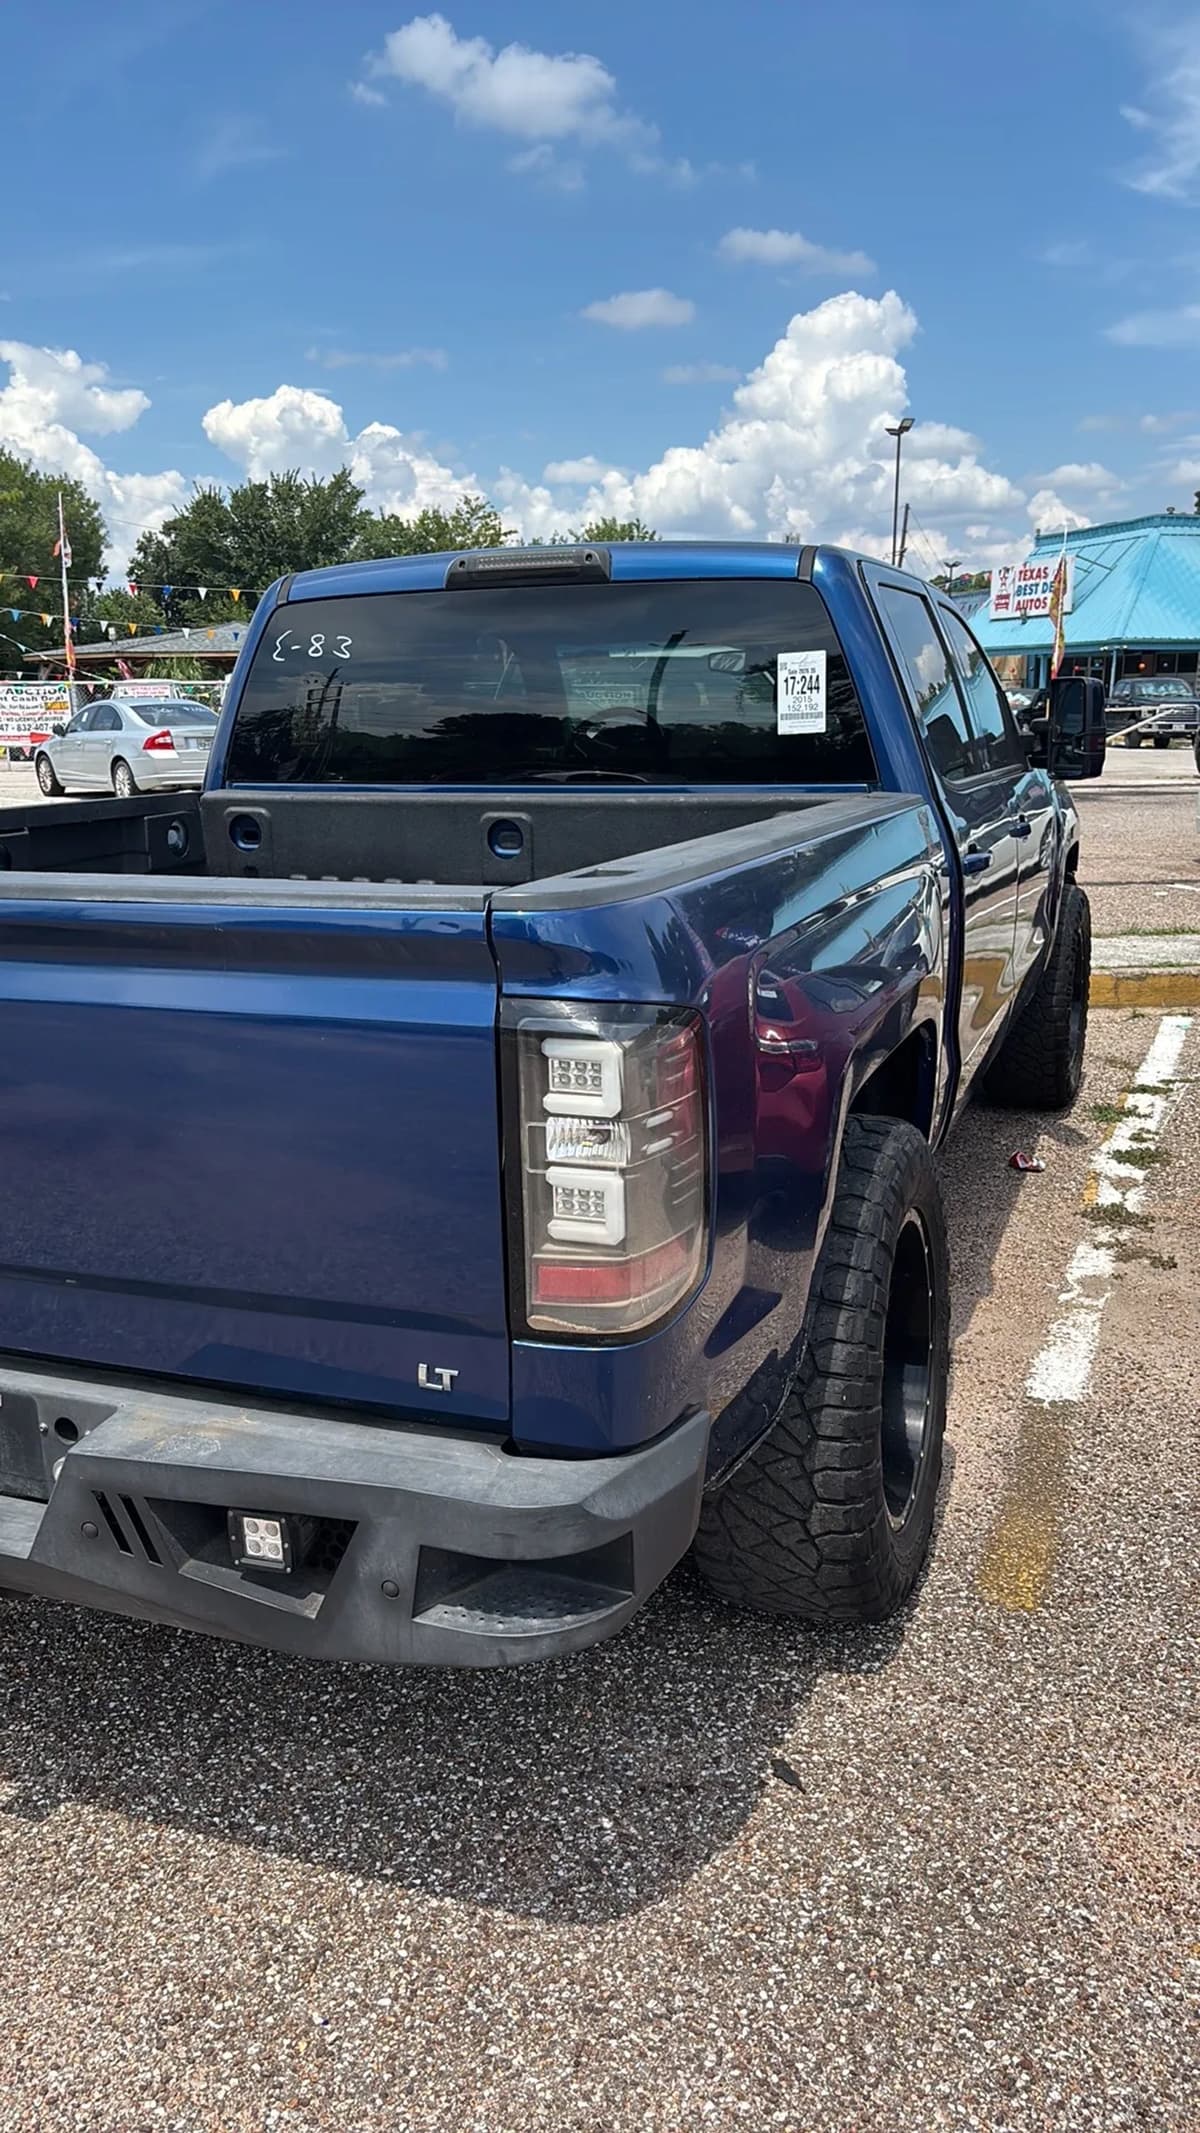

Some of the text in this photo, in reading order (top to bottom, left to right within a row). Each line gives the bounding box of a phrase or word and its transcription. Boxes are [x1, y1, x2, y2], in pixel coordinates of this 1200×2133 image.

[1018, 567, 1048, 582] TEXAS
[1016, 583, 1038, 597] BEST
[1015, 597, 1047, 611] AUTOS
[6, 687, 67, 695] AUCTION
[784, 674, 820, 696] 17:244
[792, 696, 813, 704] 2015
[418, 1363, 459, 1392] LT
